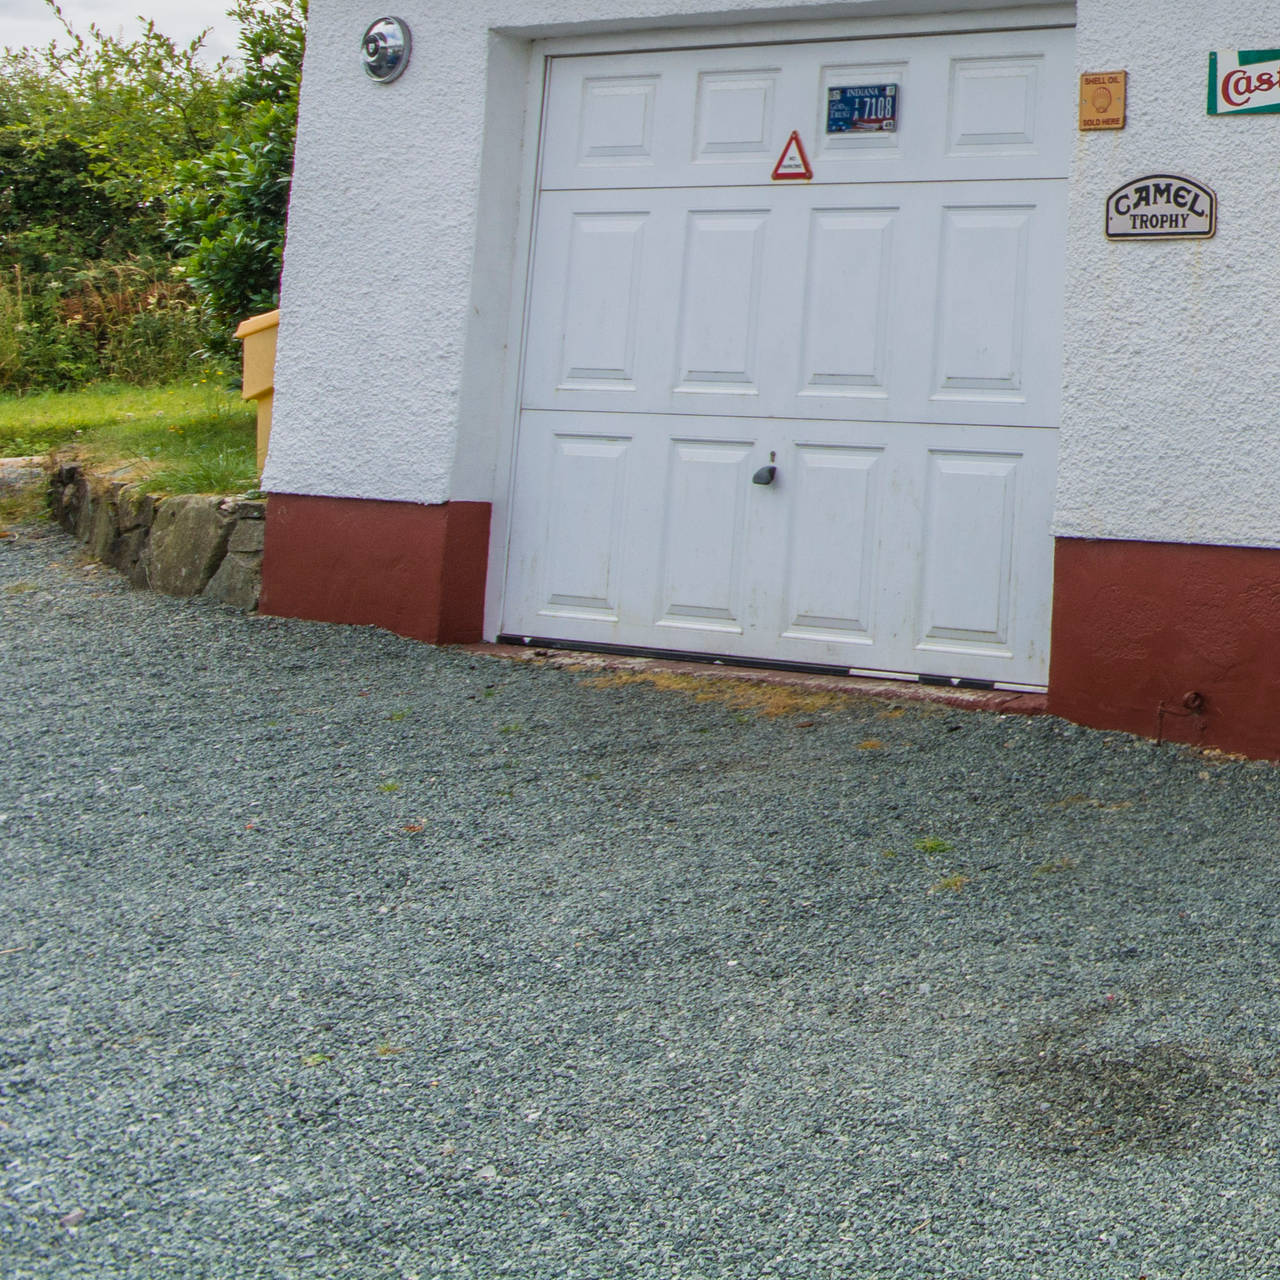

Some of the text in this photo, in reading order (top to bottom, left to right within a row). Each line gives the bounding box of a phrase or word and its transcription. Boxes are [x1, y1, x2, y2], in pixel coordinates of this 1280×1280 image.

[1084, 77, 1106, 85] SHELL
[847, 87, 879, 97] INDIANA
[864, 97, 893, 120] 7108
[1115, 183, 1205, 217] CAMEL
[1130, 213, 1190, 230] TROPHY
